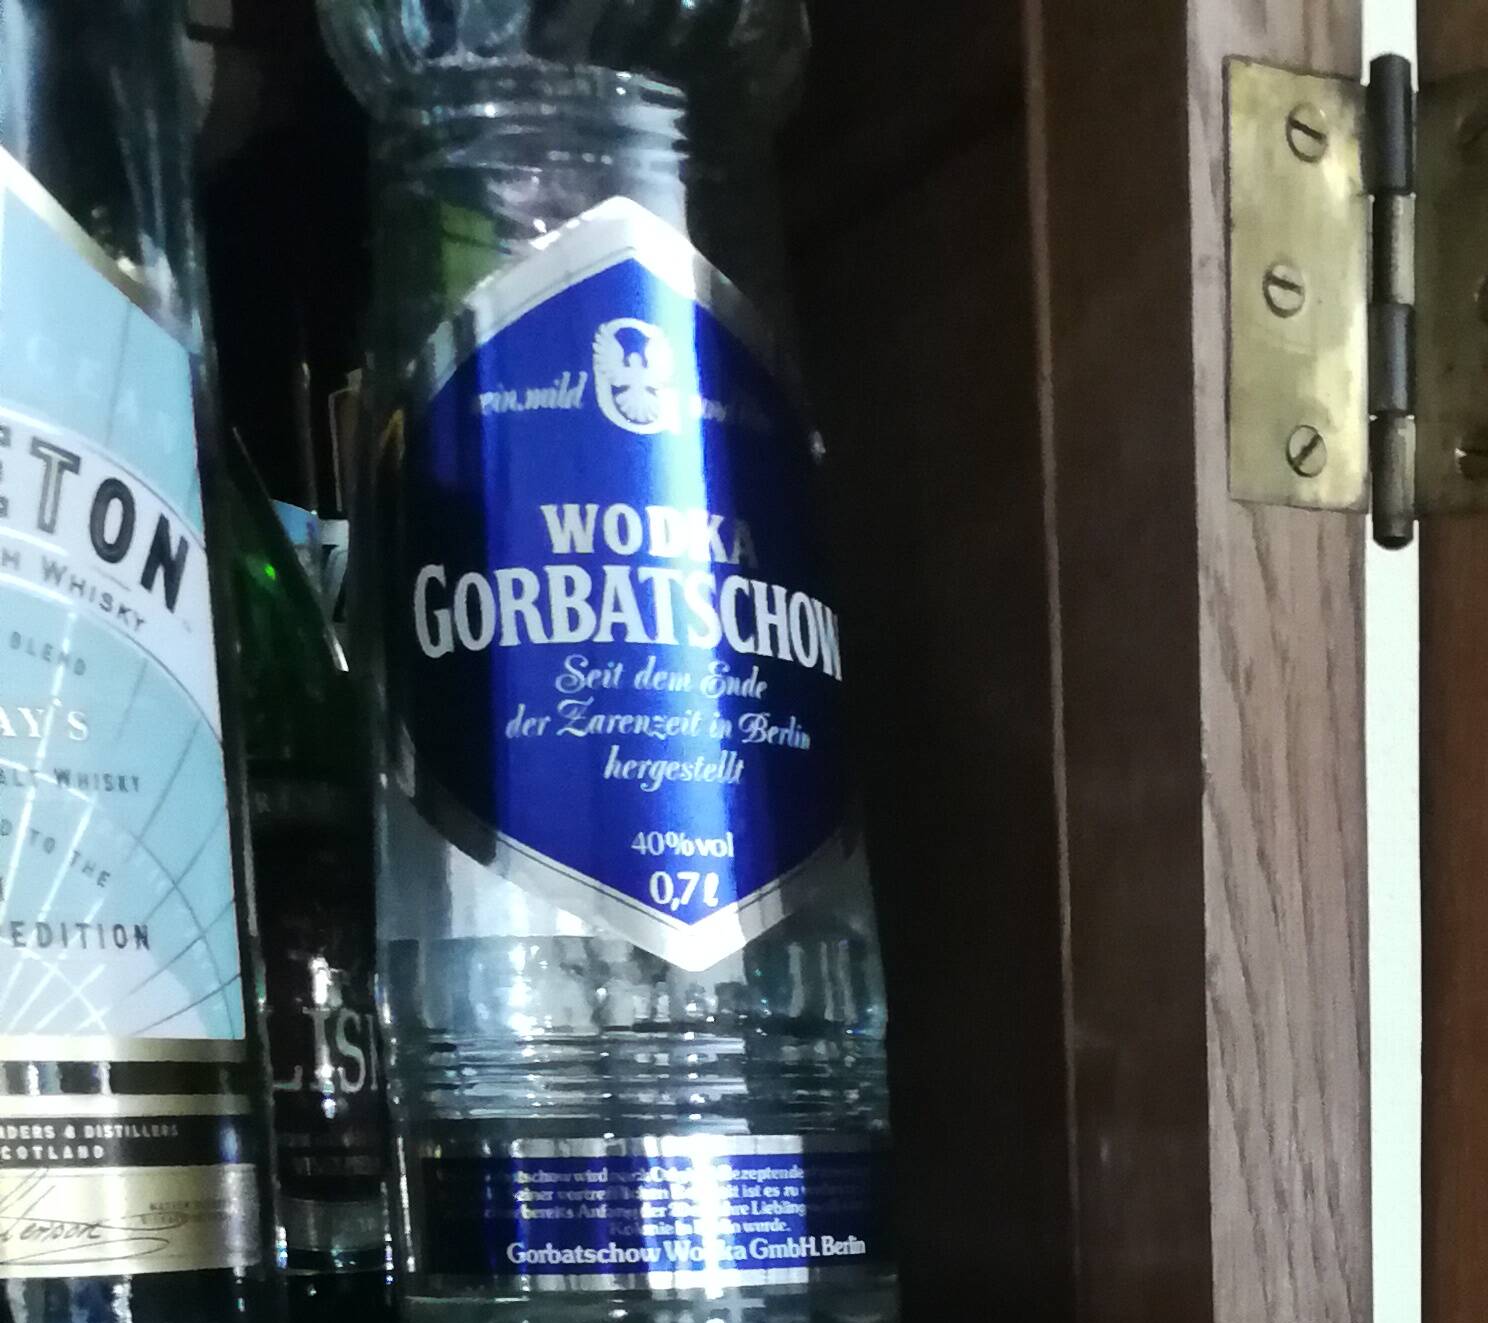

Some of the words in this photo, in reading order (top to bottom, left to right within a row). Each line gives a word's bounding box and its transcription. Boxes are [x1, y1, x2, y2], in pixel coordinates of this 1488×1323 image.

[540, 503, 760, 569] WODKA
[40, 552, 148, 632] WHISKY
[413, 562, 843, 682] GORBATSCHOW
[9, 629, 88, 678] BLEND
[554, 654, 625, 695] Seit
[633, 655, 692, 693] dem
[699, 660, 768, 700] Ende
[505, 703, 551, 740] der
[556, 697, 704, 741] Zarenzeit
[708, 712, 733, 740] in
[738, 711, 811, 751] Berlin
[53, 766, 142, 793] WHISKY
[602, 744, 745, 792] hergestellt
[71, 849, 112, 889] THE
[10, 920, 152, 951] EDITION
[83, 1123, 180, 1141] DISTILLERS
[505, 1241, 663, 1266] Gorbatschow
[663, 1239, 748, 1264] Woka
